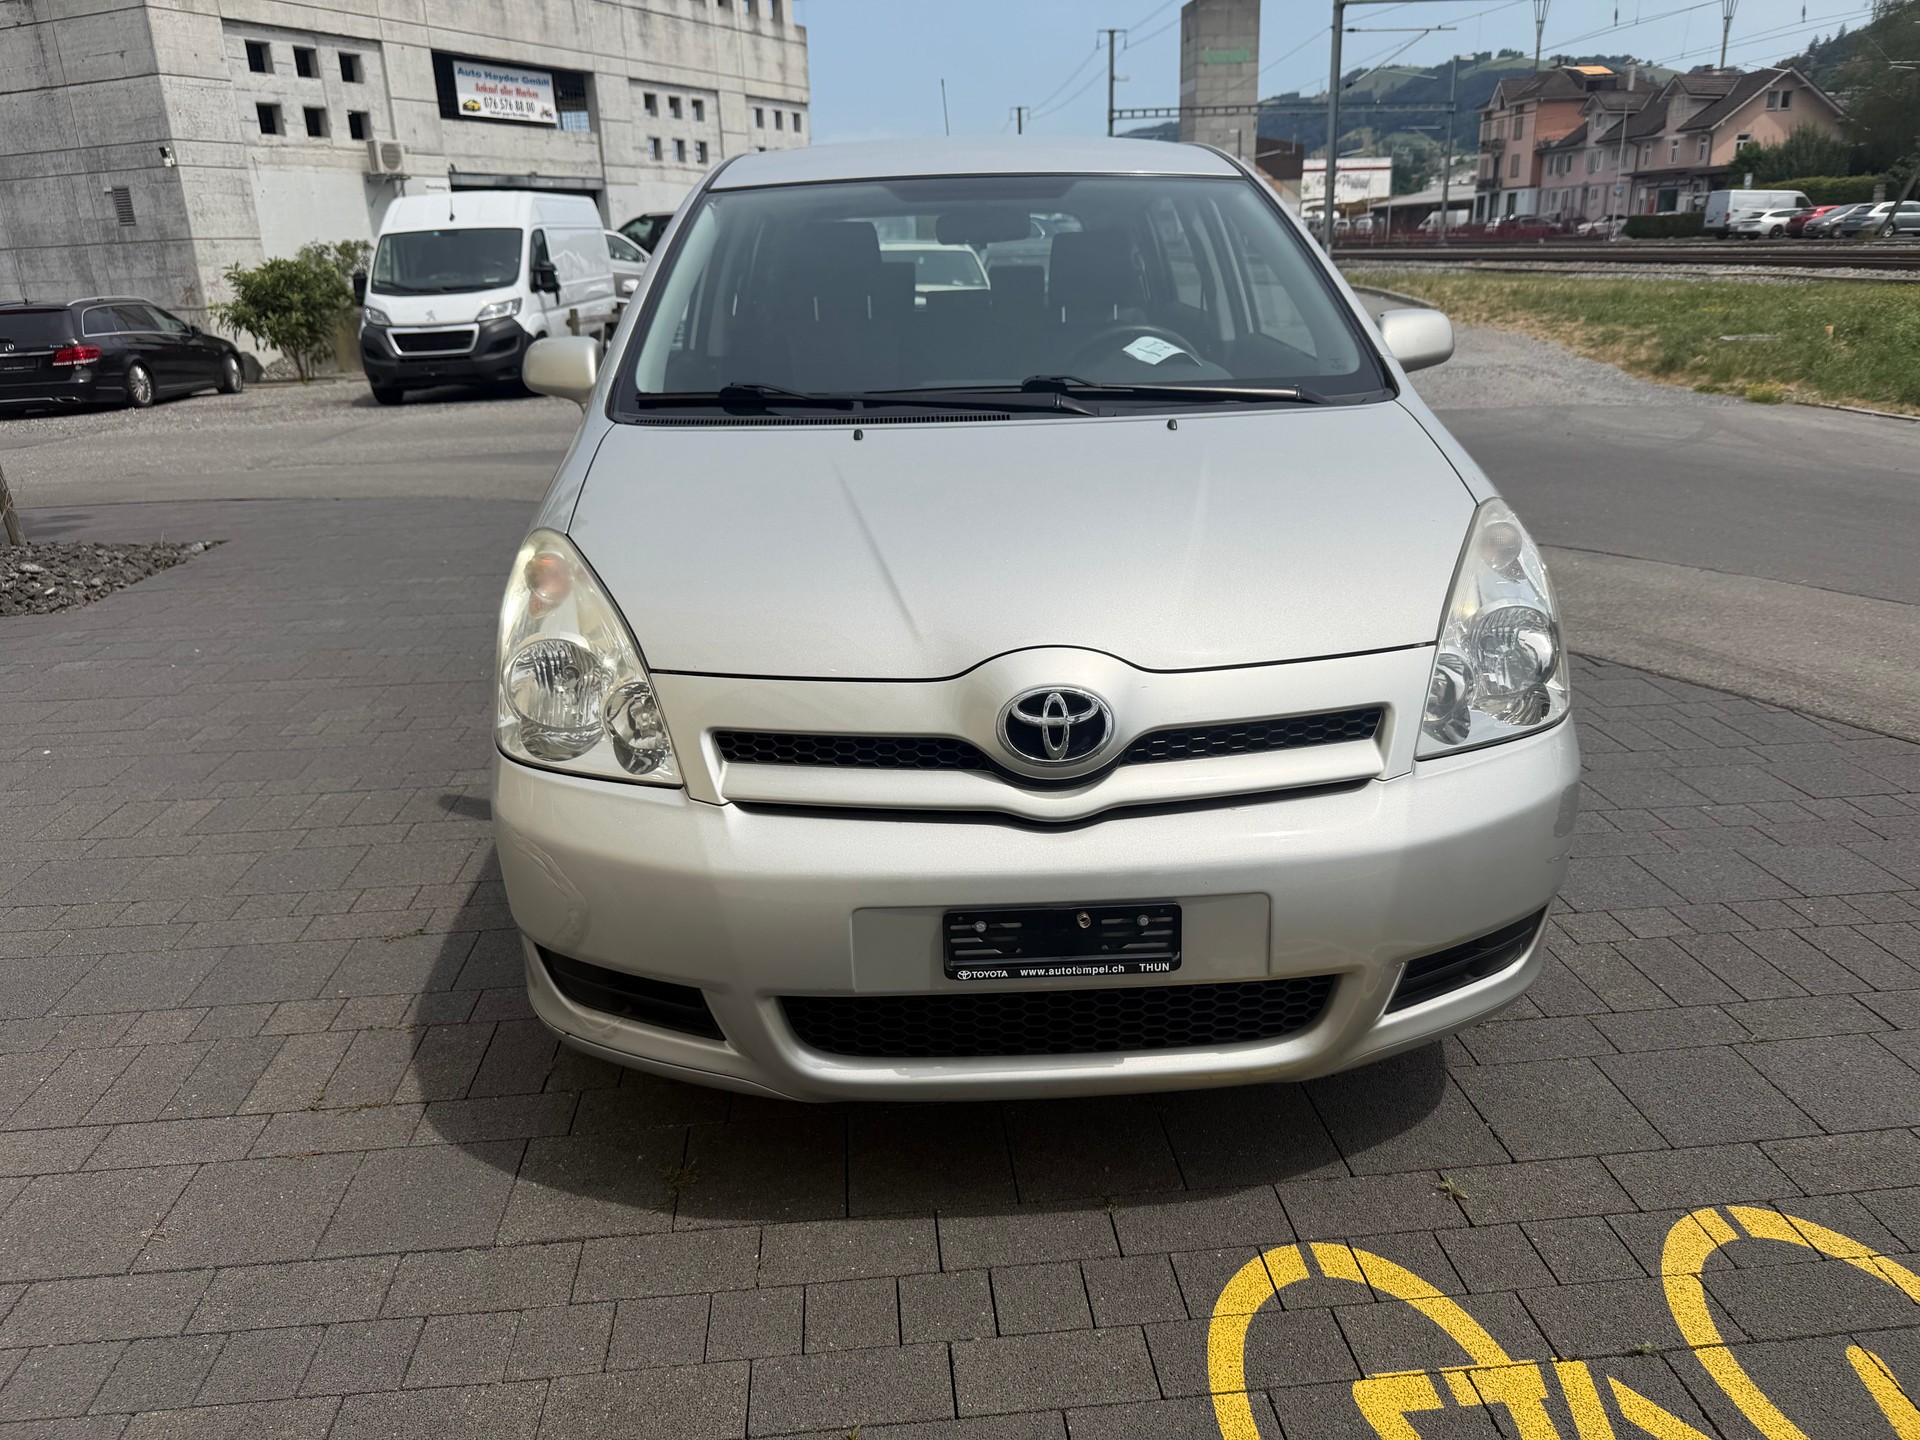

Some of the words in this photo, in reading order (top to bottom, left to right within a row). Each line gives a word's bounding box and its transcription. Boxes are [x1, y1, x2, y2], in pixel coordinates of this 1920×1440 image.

[458, 67, 481, 78] Auto
[522, 76, 550, 87] GmbH
[484, 96, 498, 109] 076
[972, 970, 1008, 978] TOYOTA
[1139, 962, 1170, 972] THUN
